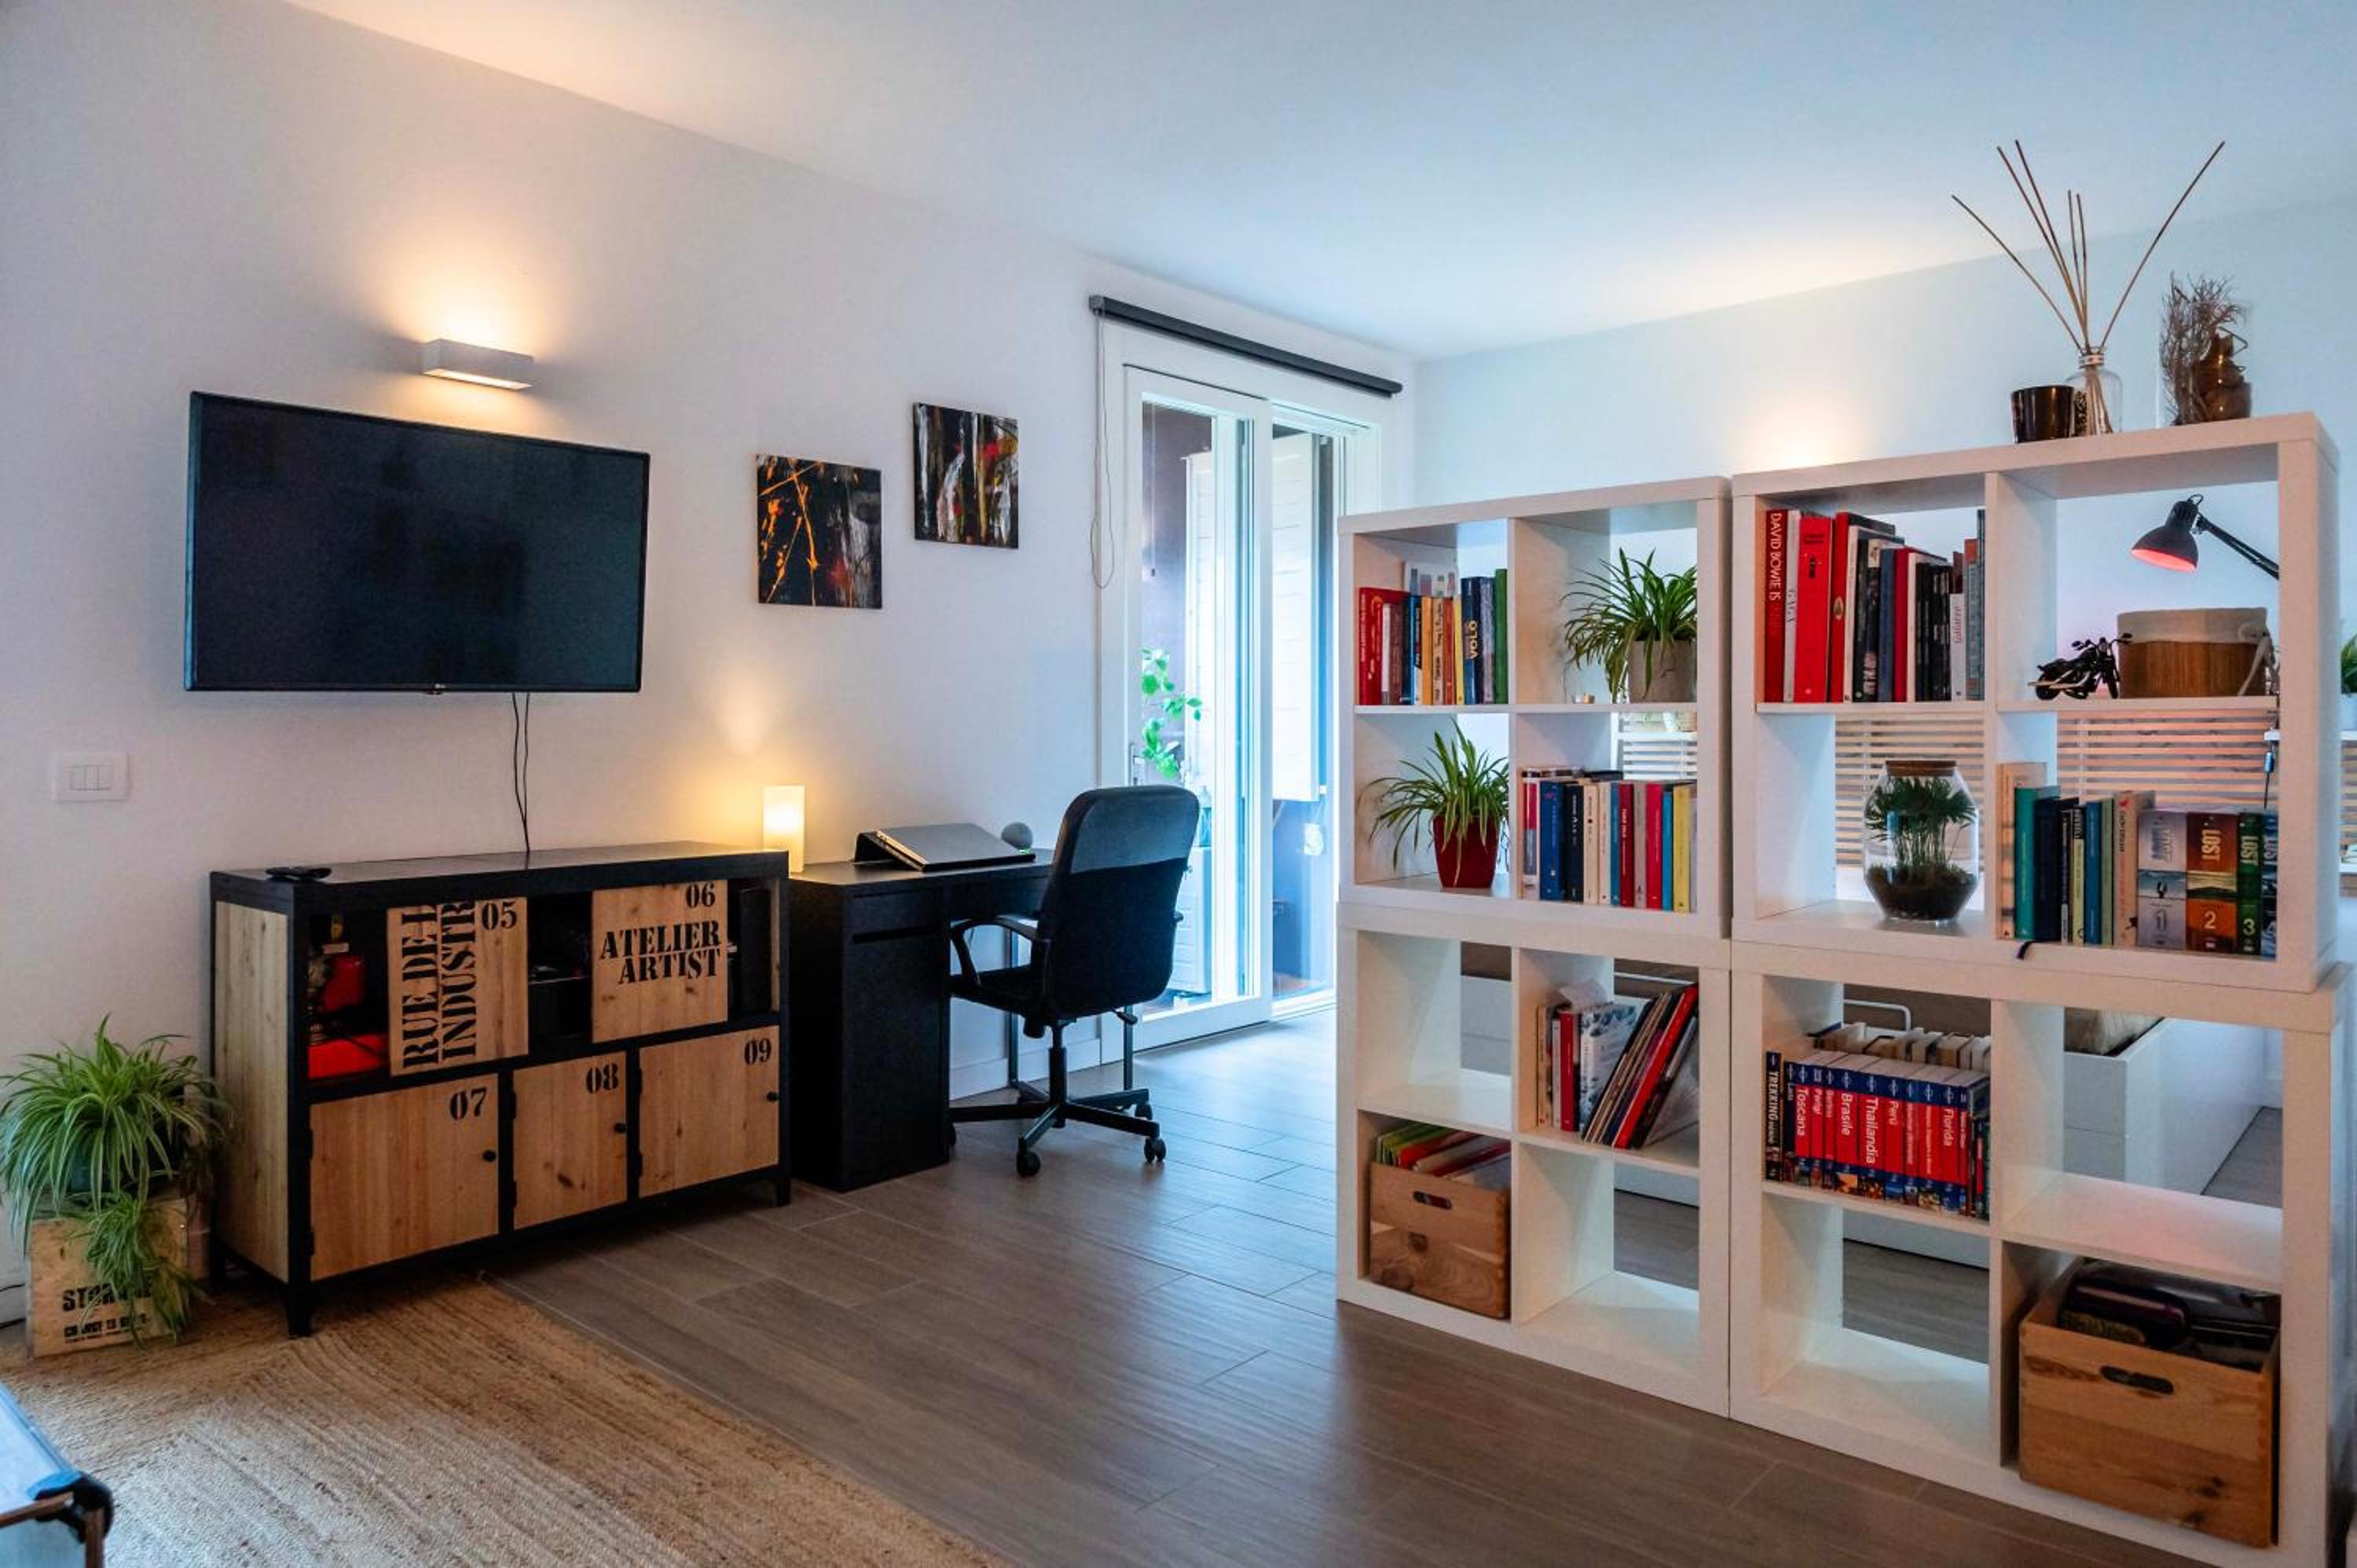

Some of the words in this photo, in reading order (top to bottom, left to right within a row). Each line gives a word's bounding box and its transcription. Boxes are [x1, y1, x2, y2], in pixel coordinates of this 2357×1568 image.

[1769, 512, 1783, 551] DAVID
[1769, 552, 1782, 589] BOWIE
[1769, 591, 1781, 601] IS
[2201, 829, 2221, 862] LOST
[2241, 835, 2260, 866] LOST
[685, 882, 716, 909] 06
[482, 900, 519, 930] 05
[2204, 910, 2216, 929] 2
[2243, 918, 2256, 936] 3
[599, 920, 720, 960] ATELIER
[401, 934, 438, 981] DE
[618, 949, 721, 984] ARTIST
[401, 991, 439, 1069] RUE
[743, 1039, 772, 1065] 09
[585, 1063, 619, 1094] 08
[449, 1087, 487, 1120] 07
[1768, 1071, 1780, 1121] TREKKING
[1796, 1086, 1809, 1137] Toscana
[1812, 1088, 1824, 1116] Parigi
[1840, 1093, 1853, 1137] Brasile
[1865, 1097, 1879, 1165] Thailandia
[1943, 1108, 1954, 1146] Florida
